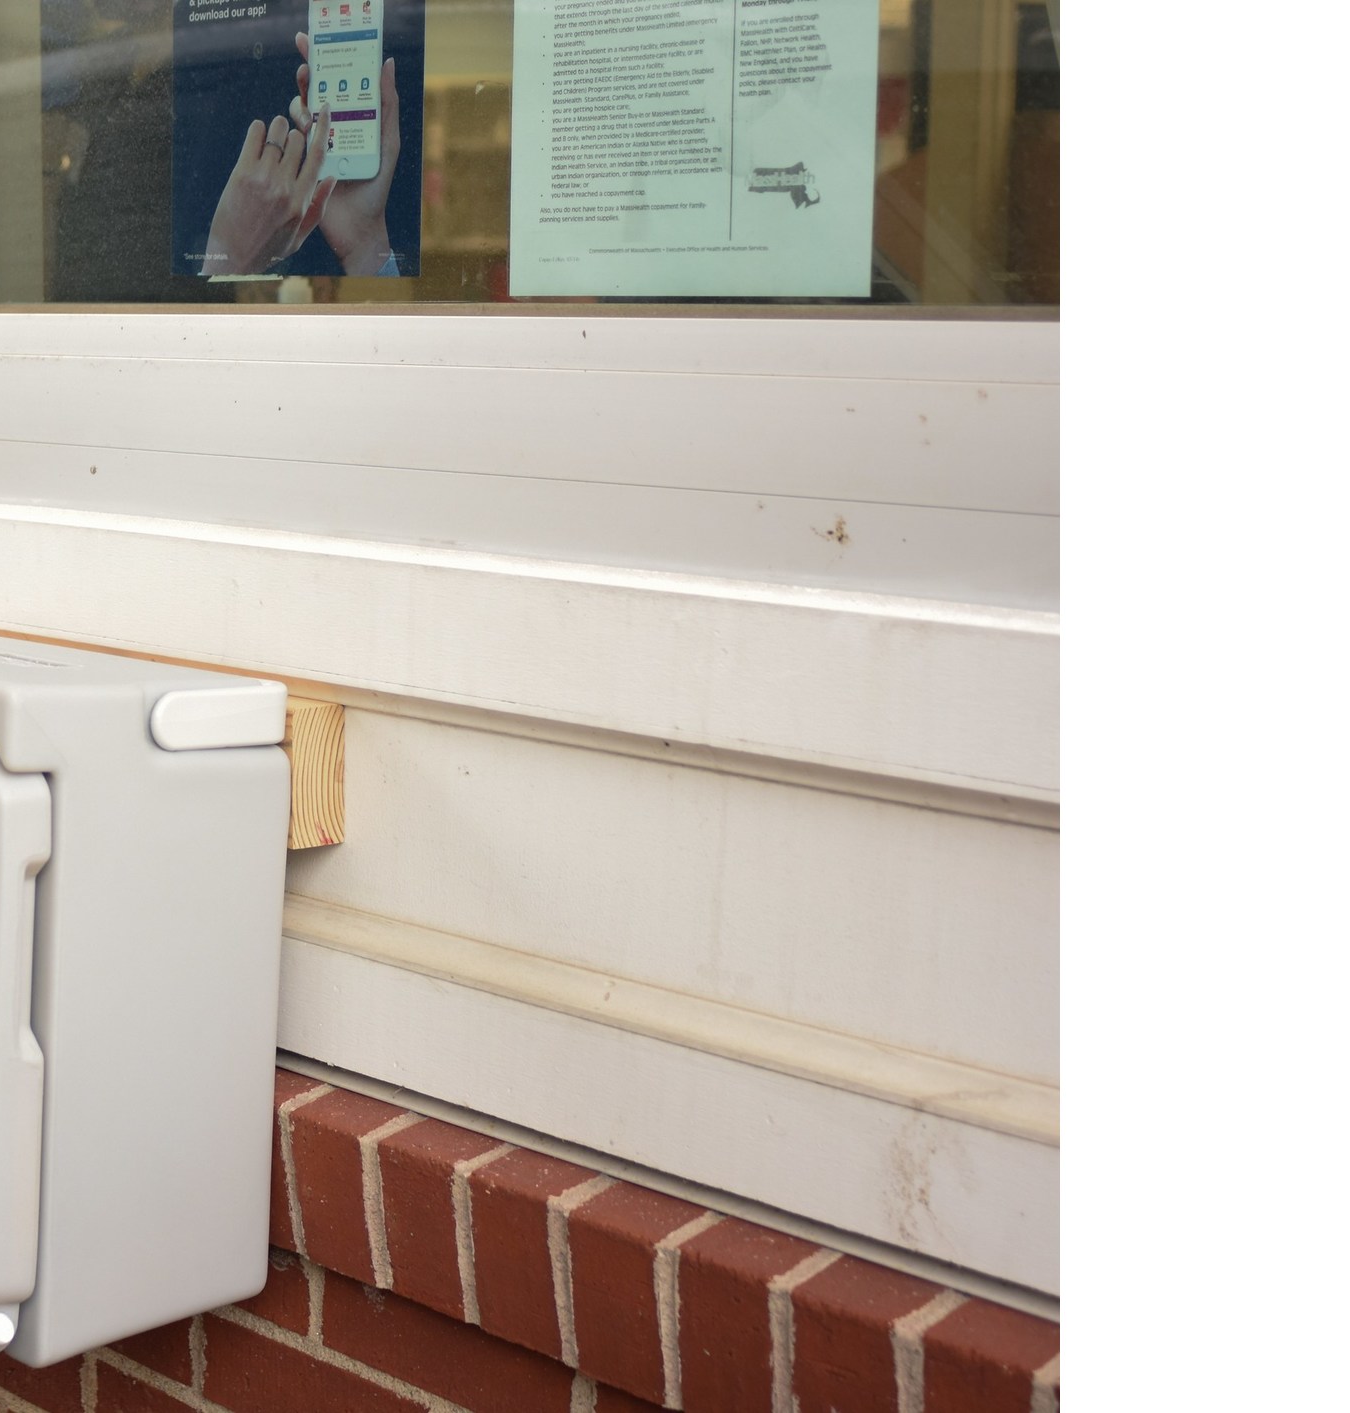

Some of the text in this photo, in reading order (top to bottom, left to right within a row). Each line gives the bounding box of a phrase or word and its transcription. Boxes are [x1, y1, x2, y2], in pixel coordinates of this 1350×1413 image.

[190, 3, 266, 22] download our app!
[578, 19, 596, 27] month
[604, 16, 620, 25] which
[622, 16, 634, 24] your
[635, 13, 662, 23] pregnancy
[747, 20, 758, 28] you
[770, 14, 793, 24] enrolled
[795, 12, 820, 21] through
[574, 30, 594, 39] getting
[595, 27, 618, 36] benefits
[636, 22, 665, 32] MassHealth
[666, 20, 684, 29] Limited
[741, 27, 773, 36] MassHealth
[740, 38, 758, 47] Fallon,
[774, 34, 798, 43] Network
[807, 42, 826, 51] Health
[753, 57, 778, 67] England,
[792, 56, 802, 64] you
[739, 69, 767, 79] questions
[768, 66, 786, 75] about
[798, 62, 832, 73] copayment
[573, 78, 593, 87] getting
[613, 74, 645, 83] (Emergency
[692, 67, 714, 75] Disabled
[758, 78, 776, 87] please
[777, 75, 801, 84] contact
[802, 76, 815, 84] your
[739, 89, 757, 97] health
[573, 106, 593, 115] getting
[594, 104, 615, 112] hospice
[684, 136, 708, 144] currently
[604, 189, 634, 198] copayment
[539, 216, 561, 225] planning
